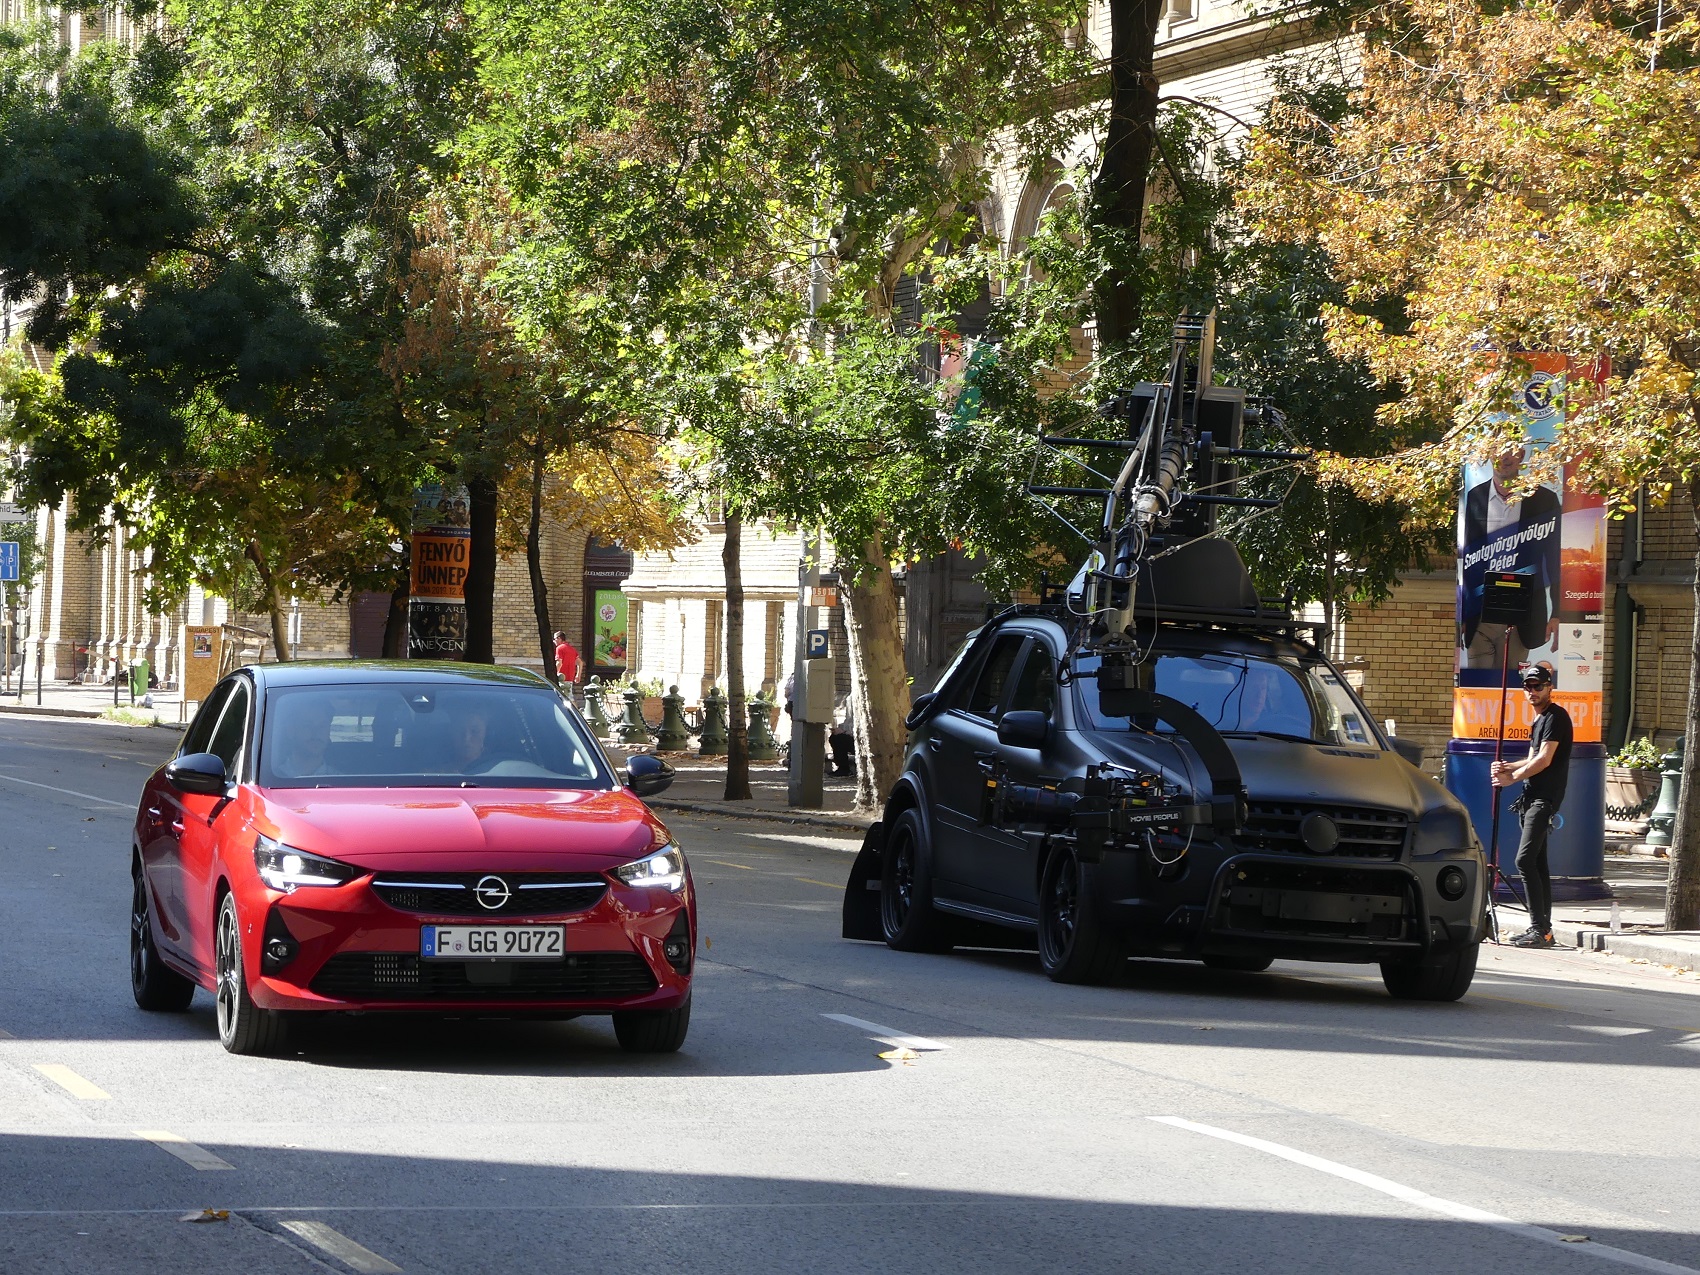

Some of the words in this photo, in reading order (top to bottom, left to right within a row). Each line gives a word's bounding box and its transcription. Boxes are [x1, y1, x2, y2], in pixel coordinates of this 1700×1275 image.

[420, 539, 465, 562] FENYŐ
[1464, 517, 1556, 570] Szentgyörgyvölgyi
[1489, 552, 1519, 572] Péter
[418, 561, 467, 586] ÜNNEP
[1564, 591, 1589, 600] Szeged
[811, 633, 825, 651] P
[1479, 725, 1500, 738] ARÉN
[438, 931, 452, 953] F
[469, 931, 497, 953] GG
[504, 931, 560, 953] 9072
